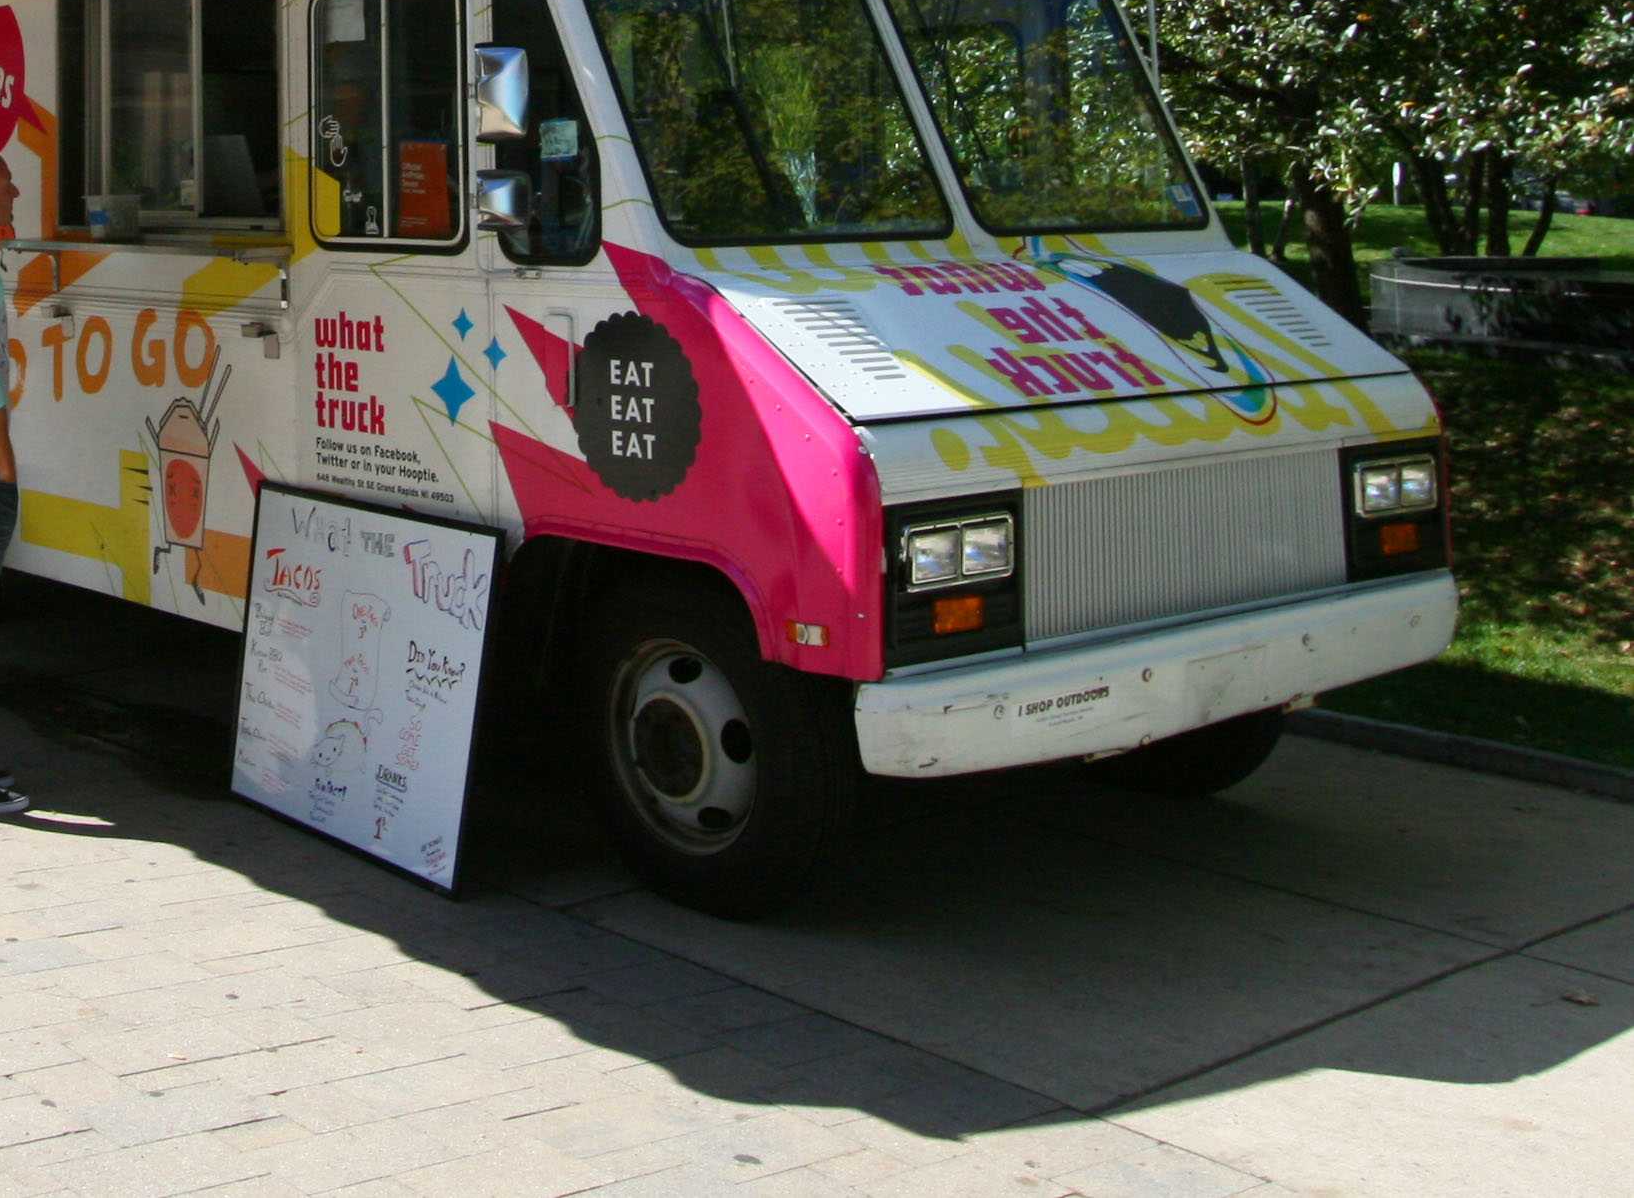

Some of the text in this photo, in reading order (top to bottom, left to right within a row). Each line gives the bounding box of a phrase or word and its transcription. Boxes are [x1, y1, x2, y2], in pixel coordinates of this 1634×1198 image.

[315, 311, 384, 352] what
[41, 314, 113, 402] TO
[131, 308, 216, 389] GO
[315, 352, 358, 392] the
[610, 359, 654, 387] EAT
[315, 391, 385, 435] truck
[611, 394, 655, 423] EAT
[316, 437, 421, 465] Follow us on Facebook,
[612, 430, 656, 459] EAT
[316, 452, 439, 483] Twitter or in your Hooptie.
[331, 474, 355, 488] Wealthy
[357, 478, 365, 488] St
[366, 480, 375, 490] SE
[376, 482, 396, 494] Grand
[397, 485, 419, 498] Rapids
[1025, 699, 1054, 716] SHOP
[1056, 685, 1110, 709] OUTDOORS
